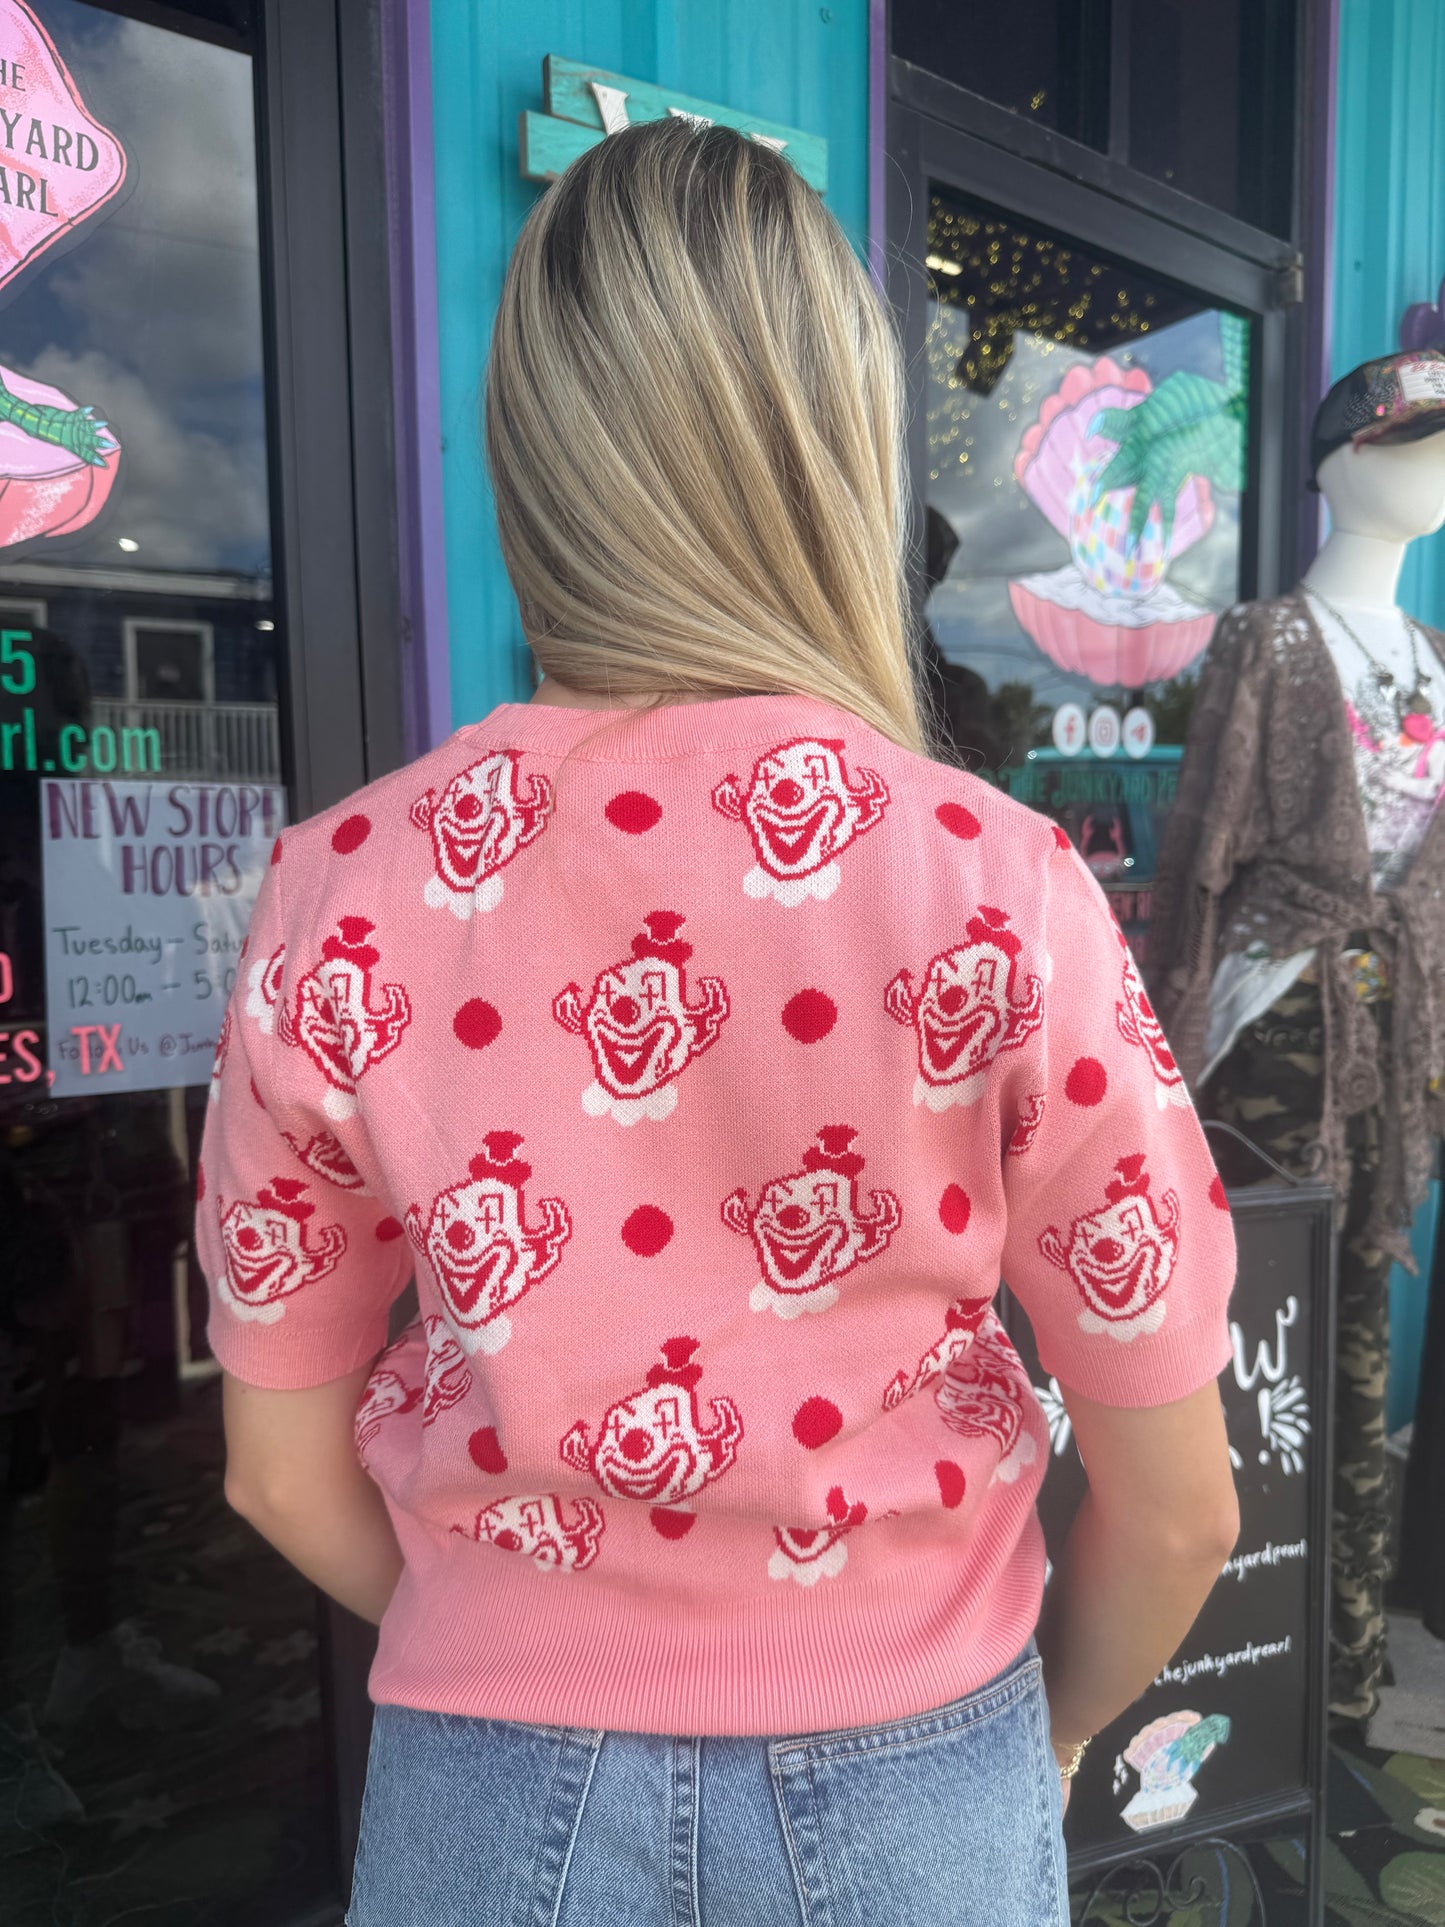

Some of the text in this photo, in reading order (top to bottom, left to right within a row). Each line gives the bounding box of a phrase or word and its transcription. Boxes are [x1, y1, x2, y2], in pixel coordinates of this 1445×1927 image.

[0, 630, 36, 695] 5
[1, 706, 161, 772] rl.com
[47, 782, 152, 840] NEW
[122, 842, 242, 896] HOURS
[52, 926, 162, 965] Tuesday
[70, 1023, 124, 1074] TX
